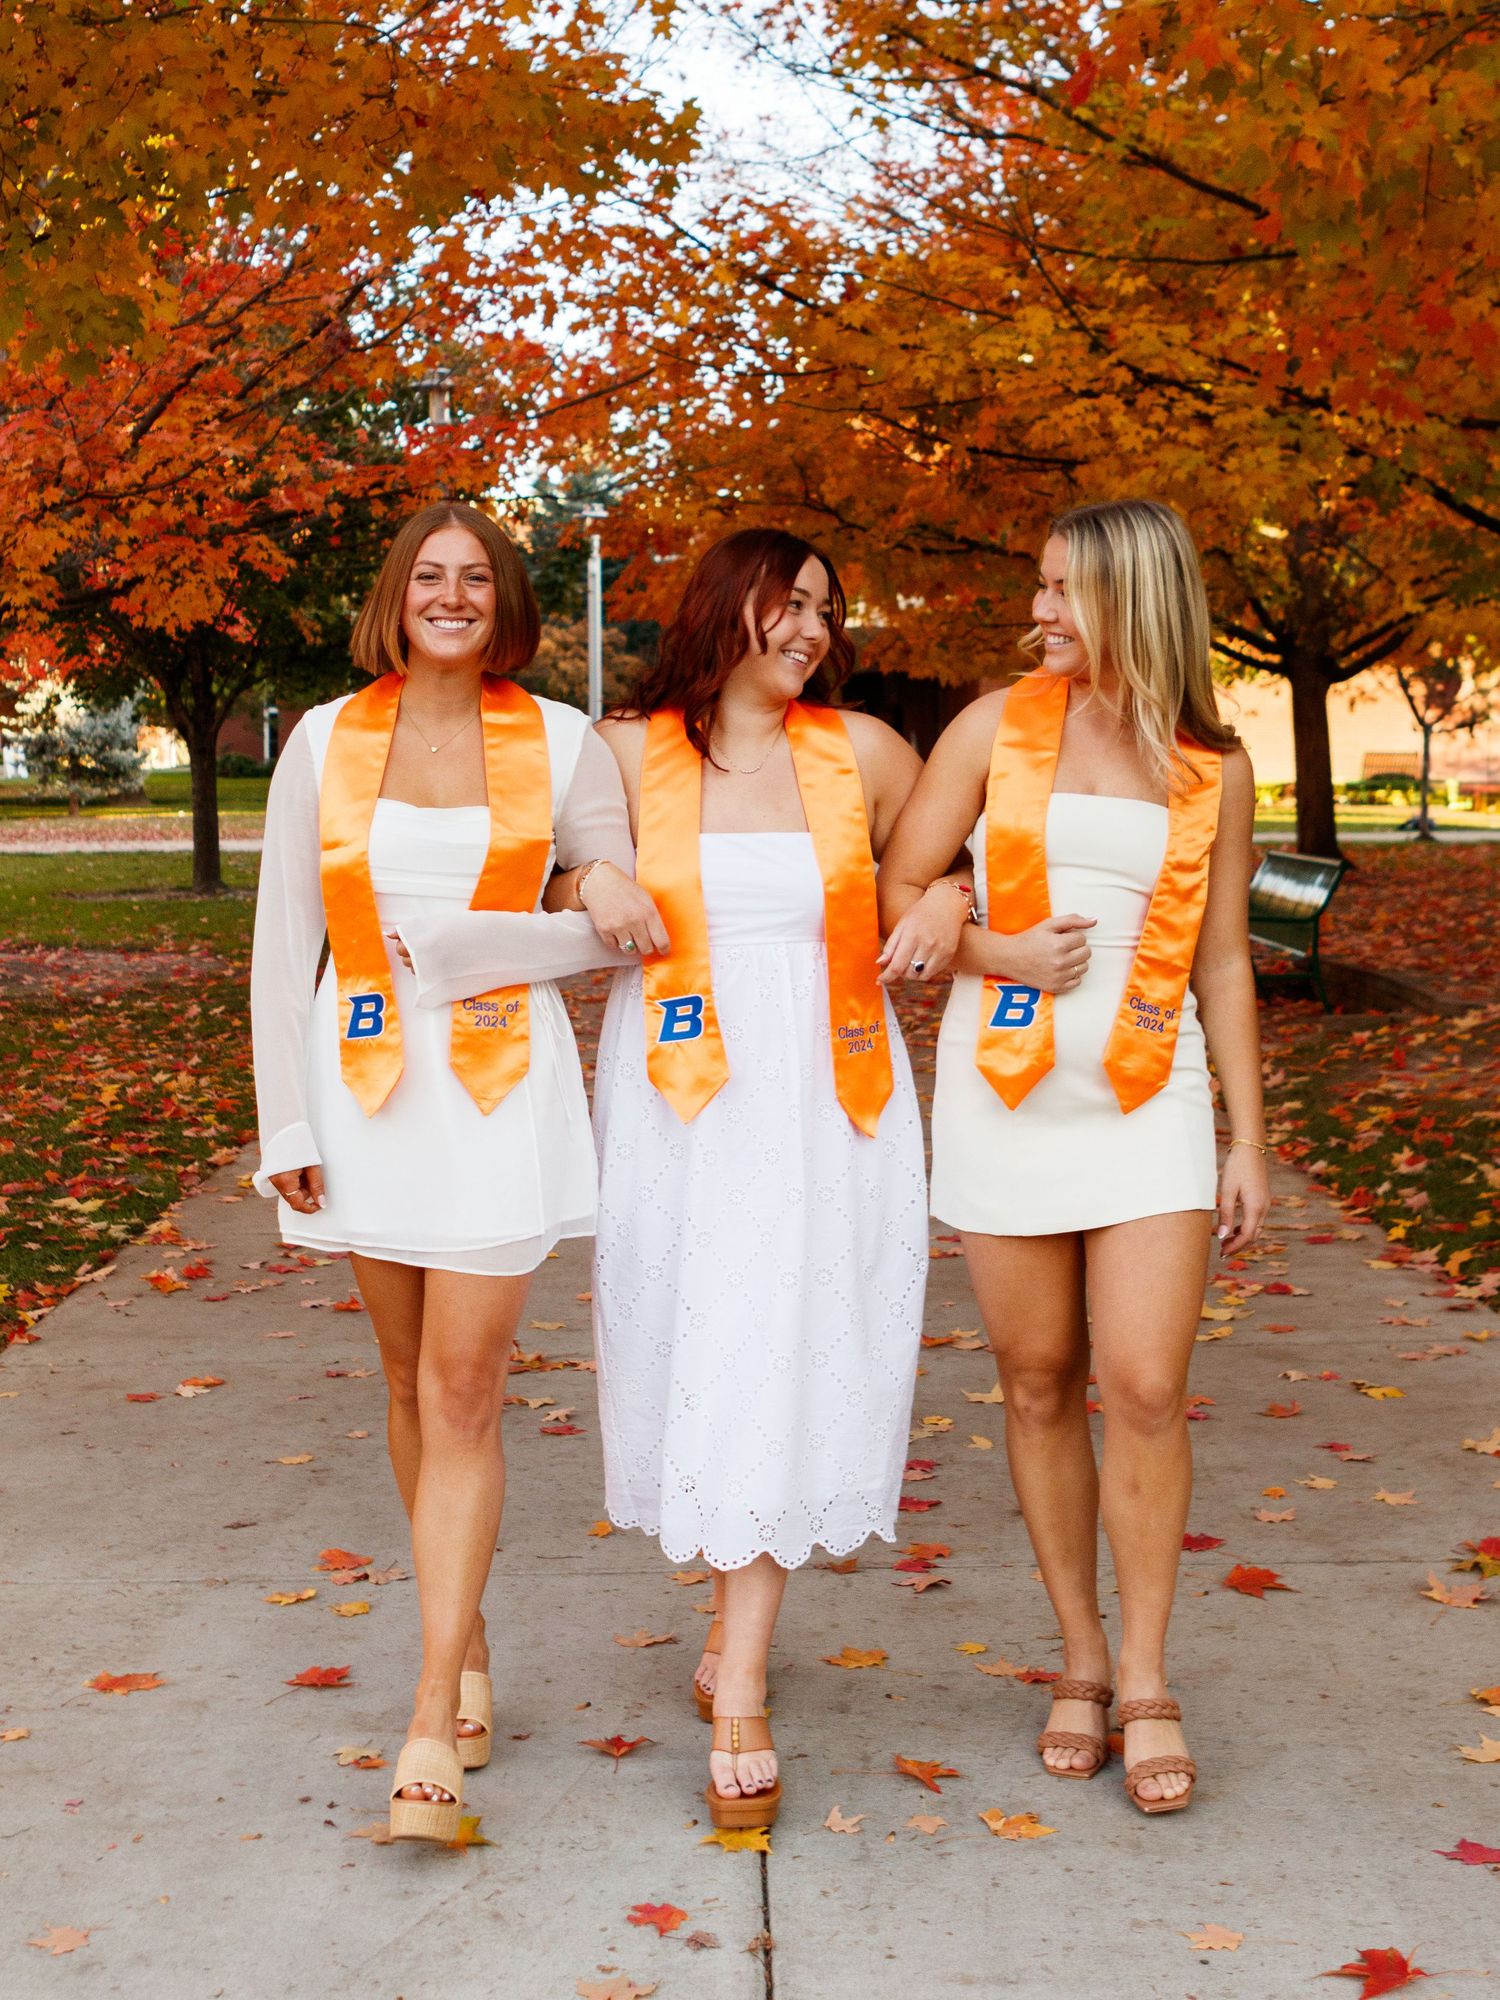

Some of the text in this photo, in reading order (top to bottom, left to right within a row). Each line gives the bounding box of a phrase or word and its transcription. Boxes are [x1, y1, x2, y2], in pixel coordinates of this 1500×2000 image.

[463, 998, 519, 1013] Class of
[986, 984, 1042, 1029] B
[1129, 996, 1176, 1020] Class of
[346, 992, 385, 1040] B
[475, 1015, 508, 1028] 2024
[657, 995, 704, 1043] B
[1135, 1015, 1165, 1033] 2024
[838, 1021, 881, 1040] Class of
[848, 1038, 874, 1053] 2024
